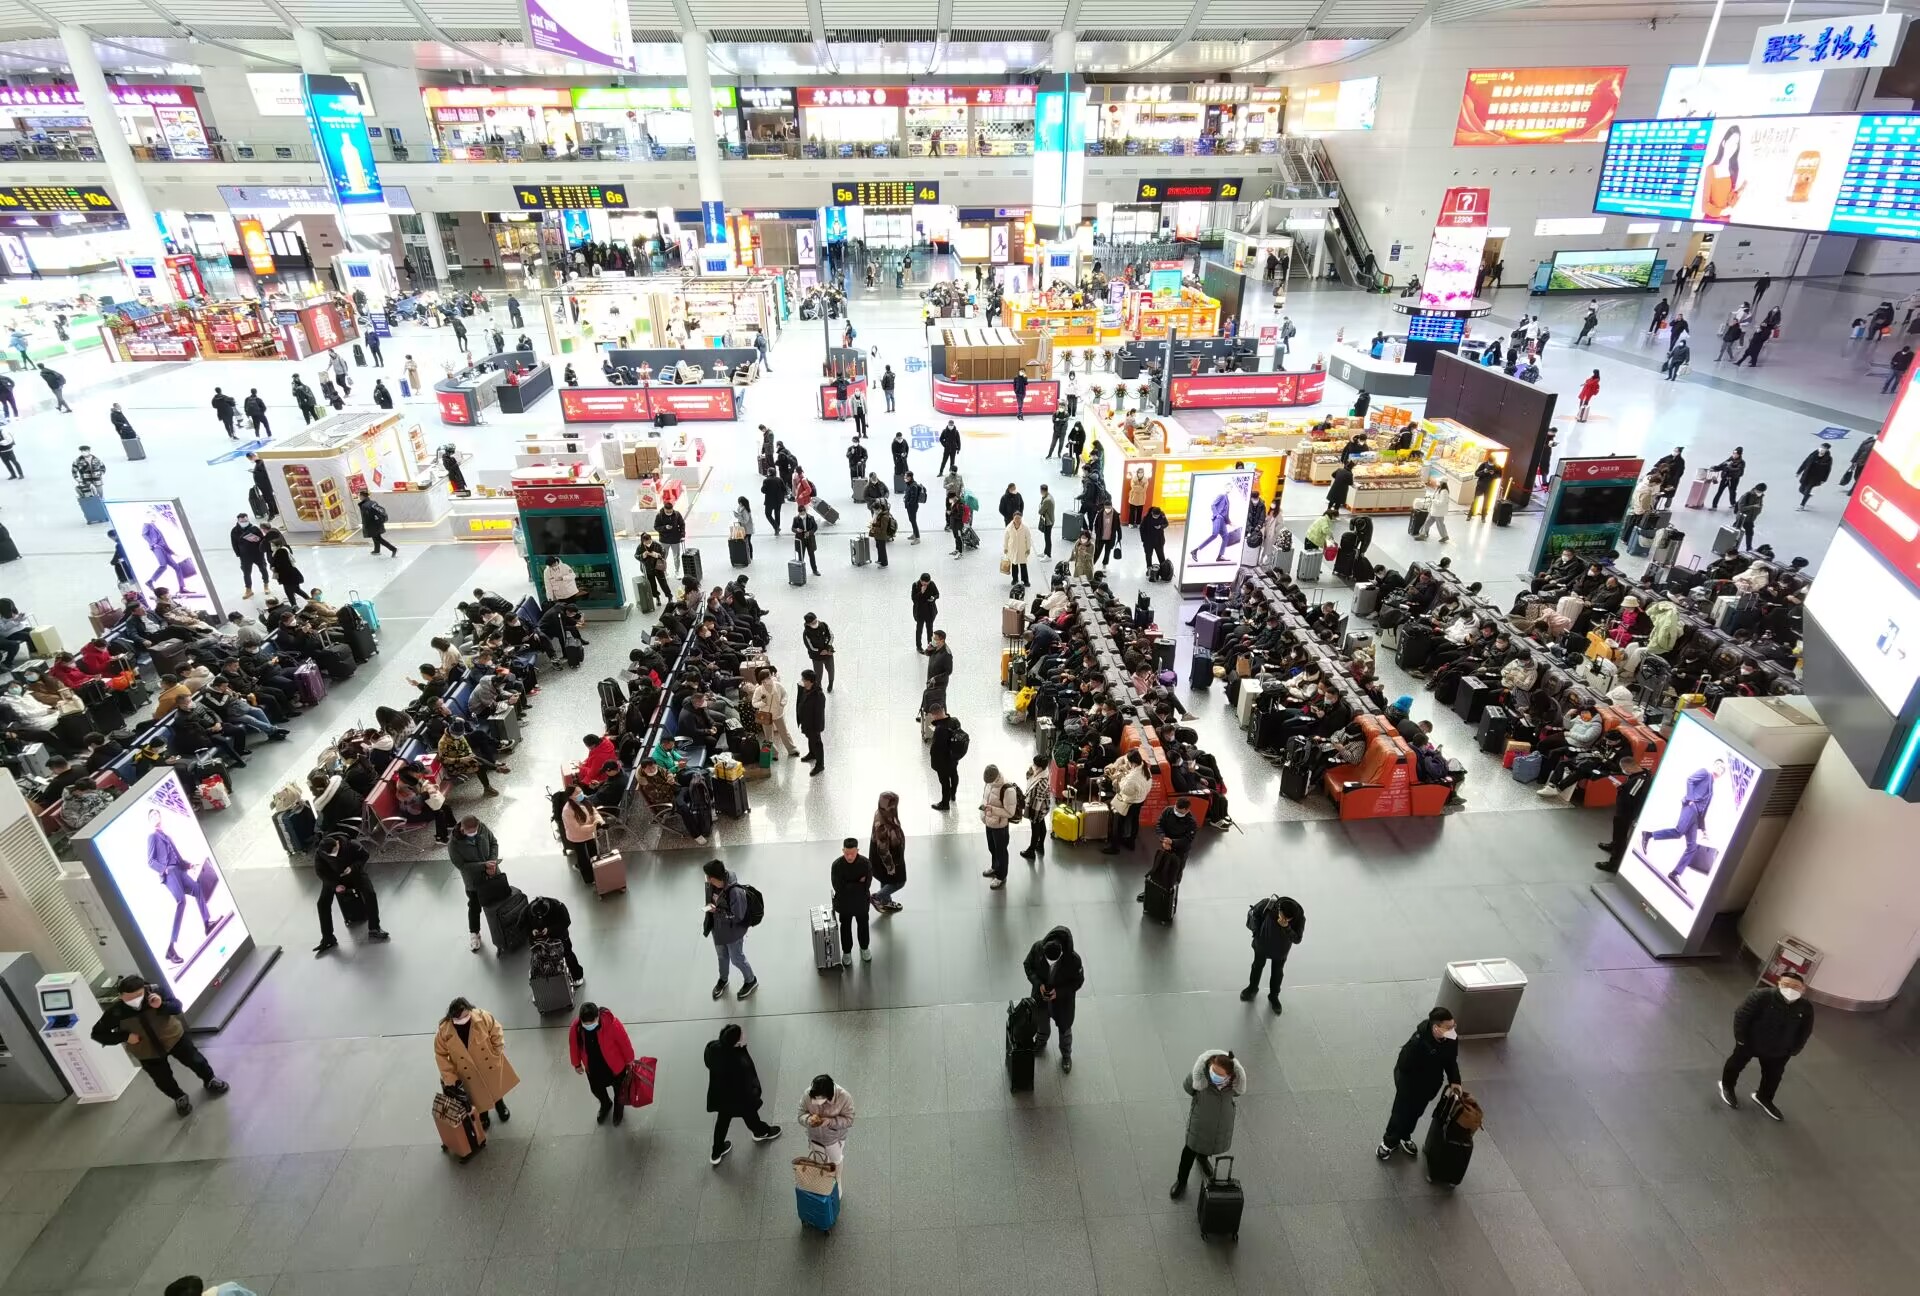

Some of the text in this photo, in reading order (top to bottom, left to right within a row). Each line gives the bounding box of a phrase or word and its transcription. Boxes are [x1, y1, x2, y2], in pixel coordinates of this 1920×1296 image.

[836, 188, 853, 202] 5B
[919, 187, 936, 200] 4B
[1141, 184, 1157, 197] 3B
[1221, 183, 1238, 196] 2B
[84, 192, 112, 206] 10B
[520, 191, 538, 204] 7B
[605, 190, 624, 204] 6B
[1453, 215, 1473, 224] 12306
